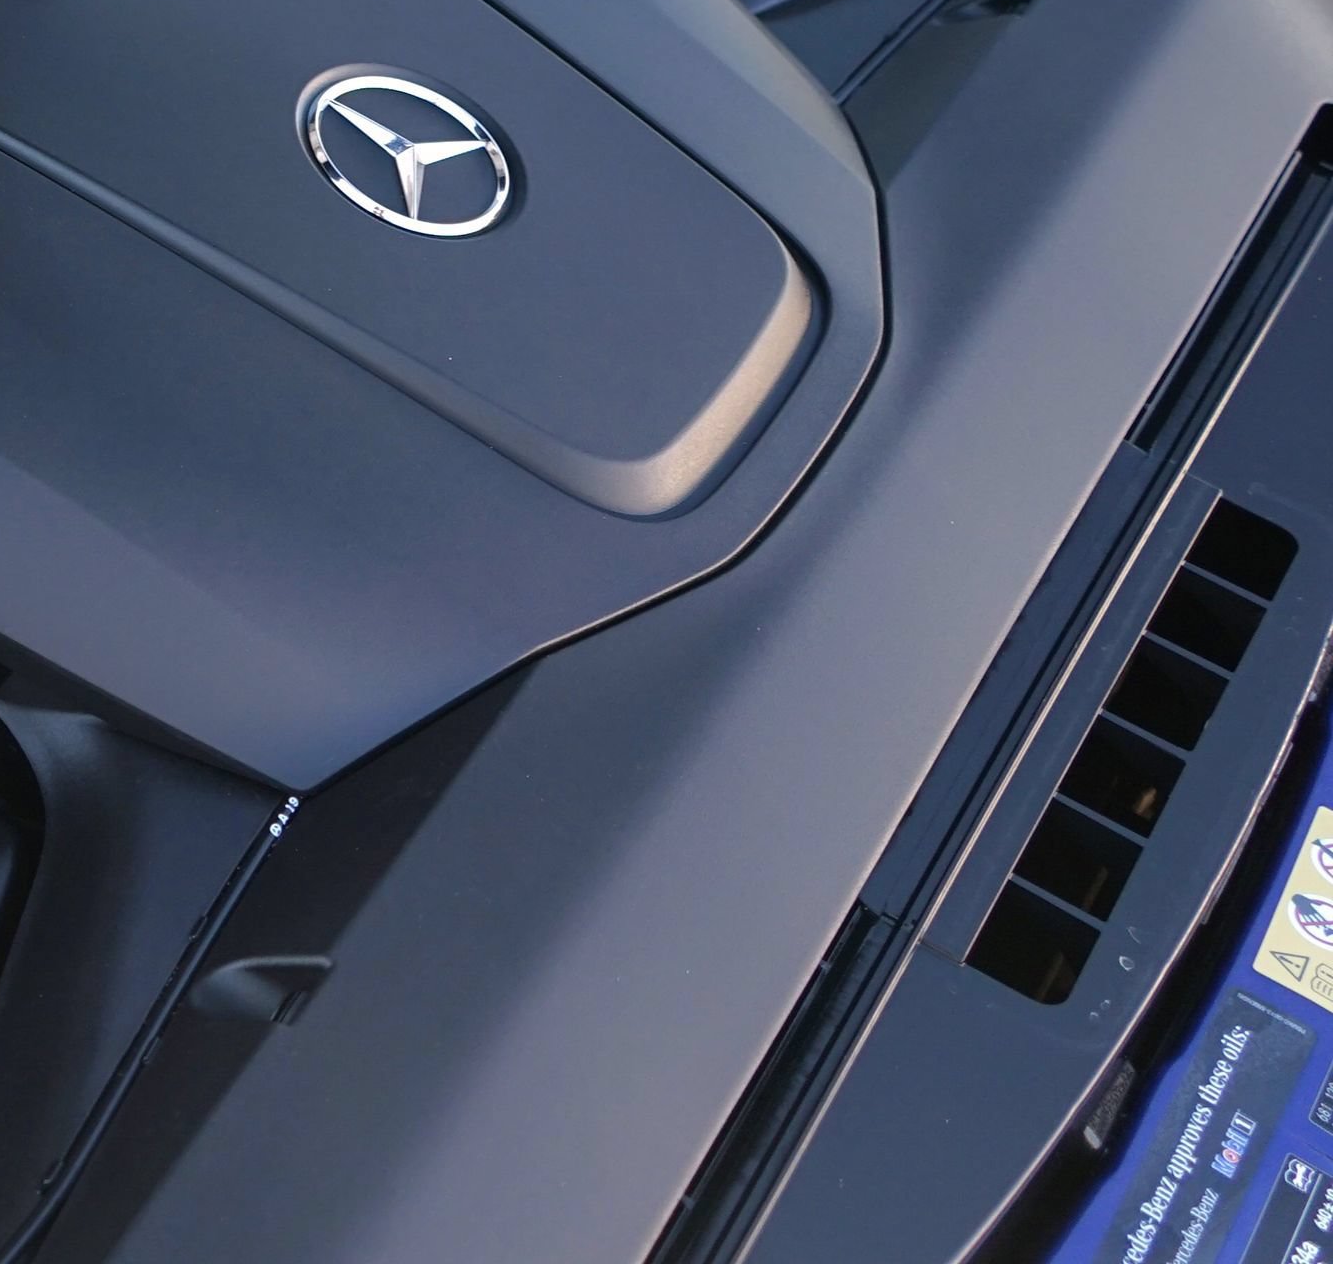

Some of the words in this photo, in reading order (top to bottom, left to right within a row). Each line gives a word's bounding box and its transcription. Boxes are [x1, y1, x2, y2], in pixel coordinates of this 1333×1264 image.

[1167, 1102, 1213, 1179] approves
[1198, 1059, 1233, 1106] these
[1221, 1024, 1253, 1062] oils:
[1211, 1127, 1250, 1179] Mobil
[1314, 1208, 1333, 1232] 640
